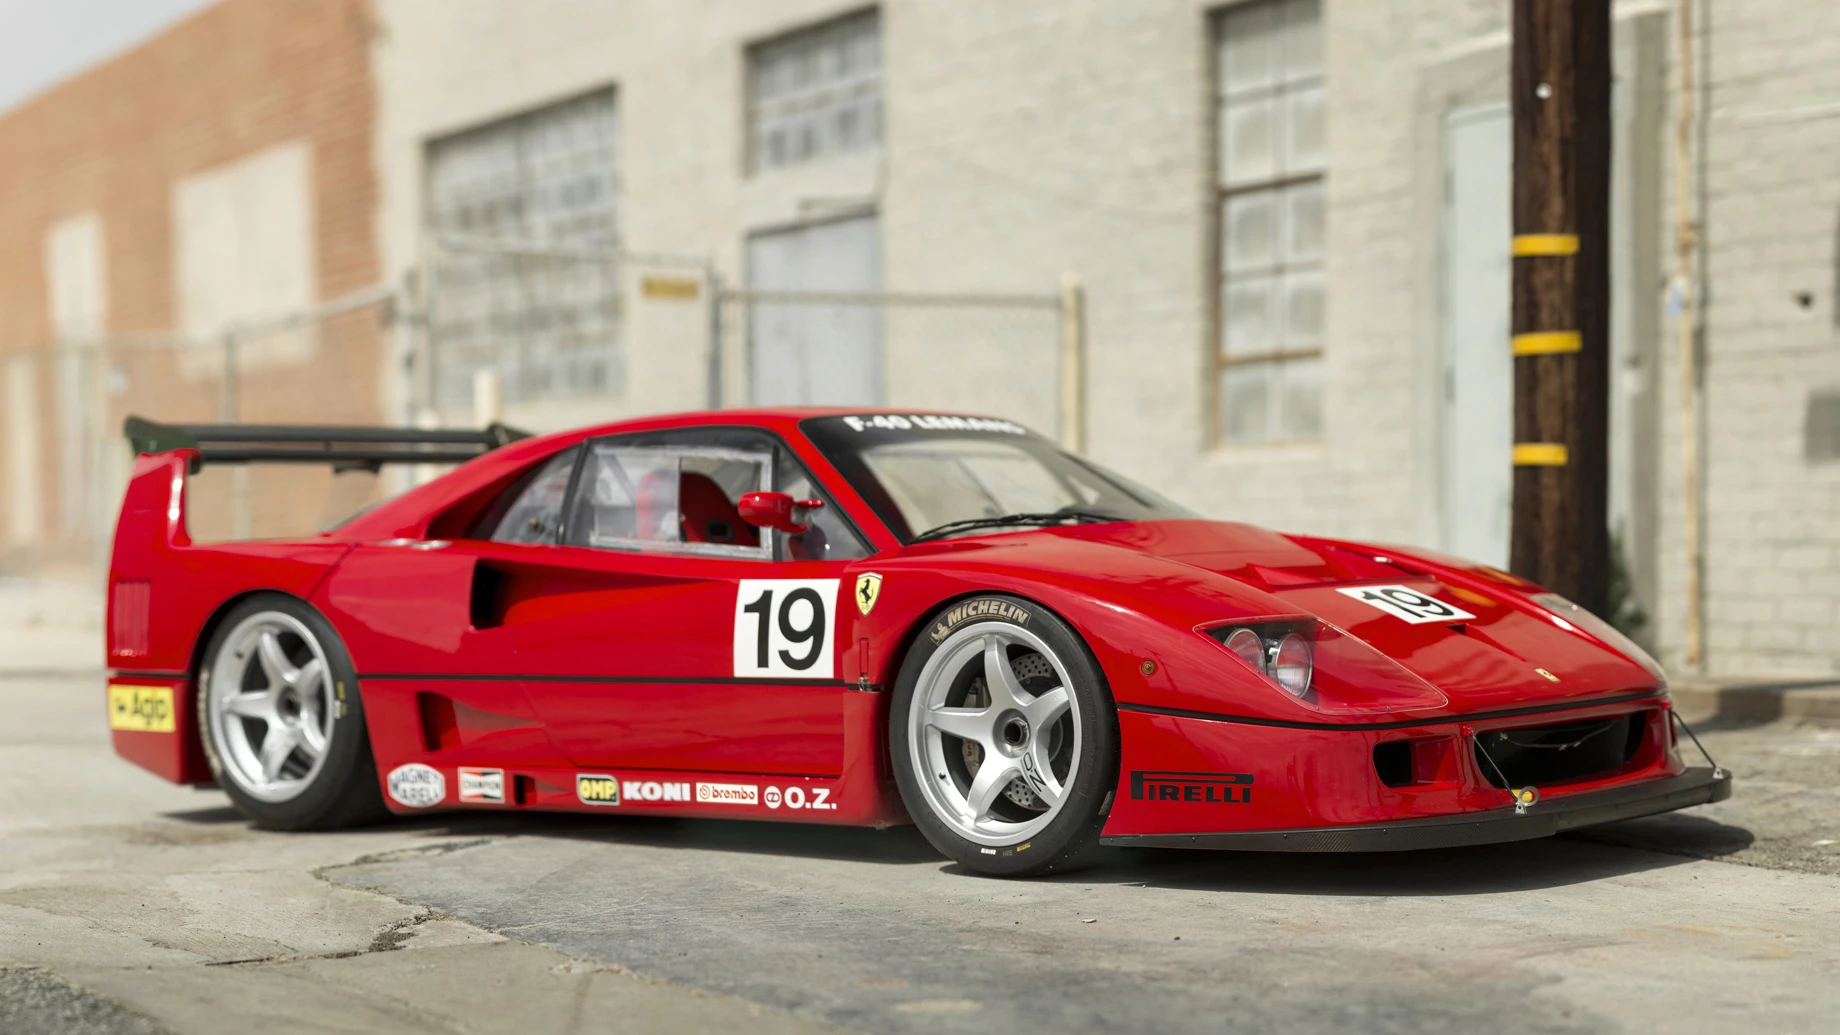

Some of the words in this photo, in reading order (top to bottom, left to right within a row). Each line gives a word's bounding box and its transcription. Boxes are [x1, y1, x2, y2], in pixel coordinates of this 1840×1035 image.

[843, 415, 912, 432] F-40
[947, 600, 1028, 627] MICHELIN
[1360, 589, 1454, 618] 19
[744, 587, 825, 671] 19
[131, 691, 168, 727] Agip
[580, 779, 616, 799] OMP
[623, 781, 691, 801] KONI
[712, 786, 755, 800] brembo
[784, 786, 837, 810] O.Z.
[1130, 770, 1254, 803] PIRELLI
